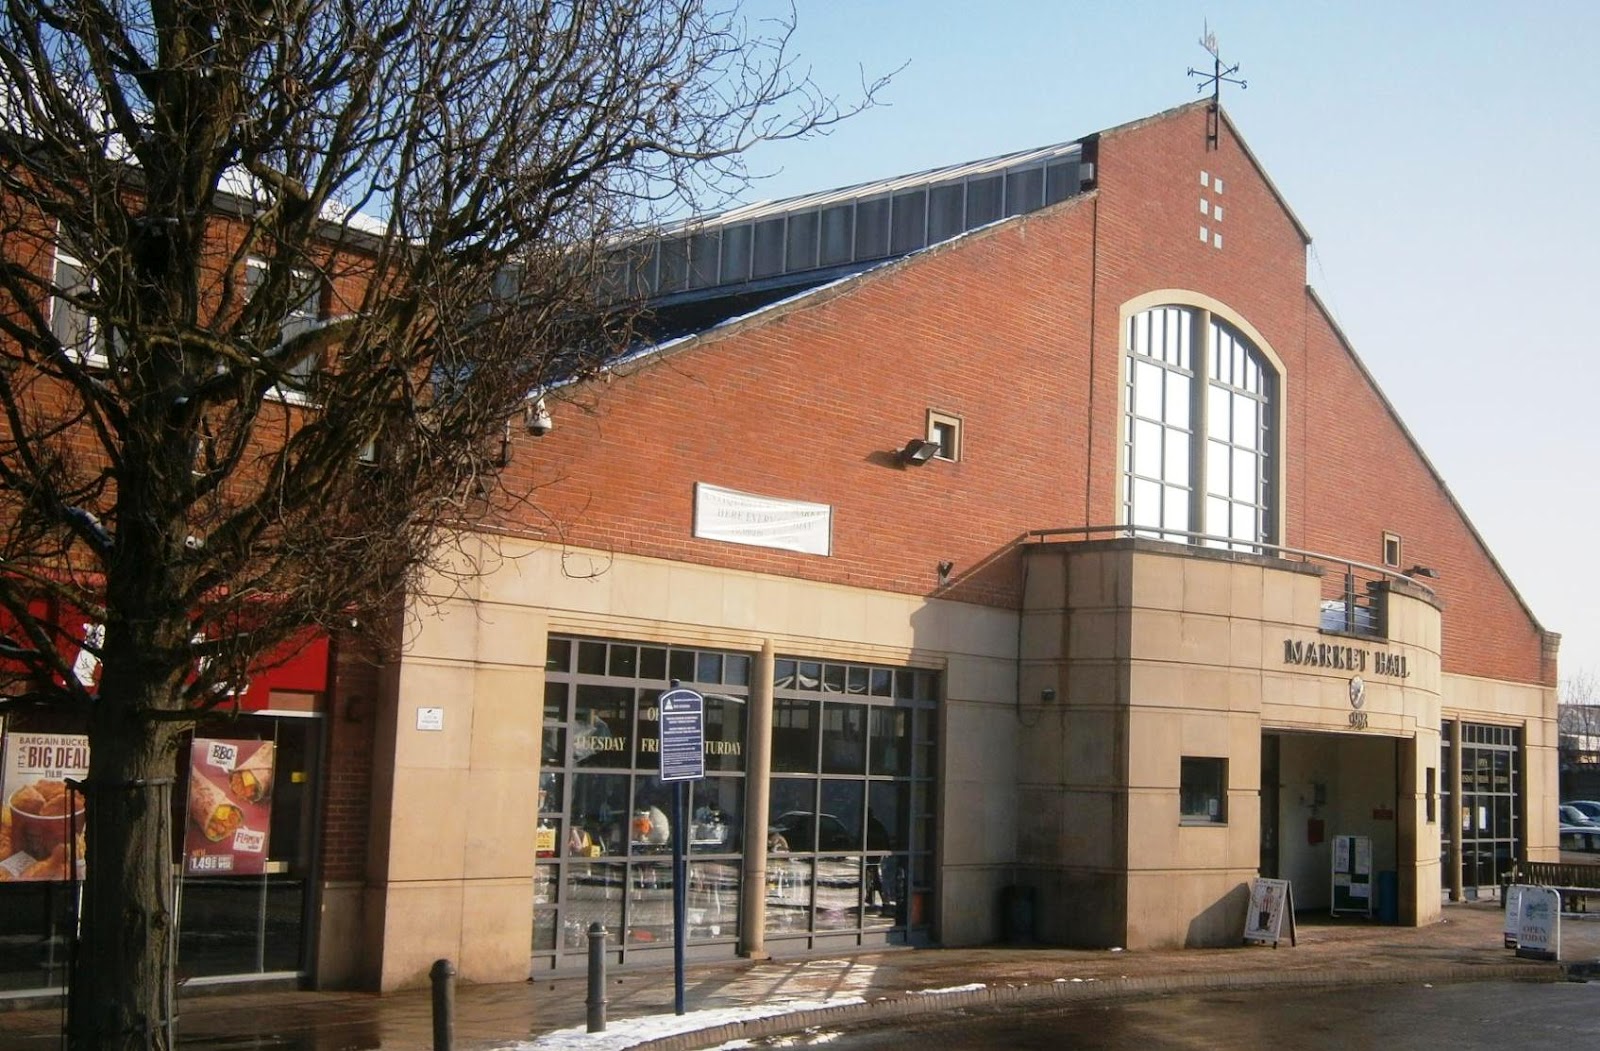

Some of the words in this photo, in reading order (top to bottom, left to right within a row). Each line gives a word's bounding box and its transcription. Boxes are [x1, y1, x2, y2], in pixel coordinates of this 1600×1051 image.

[1283, 639, 1370, 672] MARKET
[1374, 651, 1410, 678] HALL
[19, 736, 59, 745] BARGAIN
[60, 738, 89, 747] BUCKE
[575, 736, 626, 751] TUESDAY
[28, 746, 52, 769] BIG
[55, 747, 89, 769] DEAL
[213, 745, 234, 760] BBQ
[1523, 926, 1546, 934] OPEN
[1521, 934, 1547, 943] TODAY
